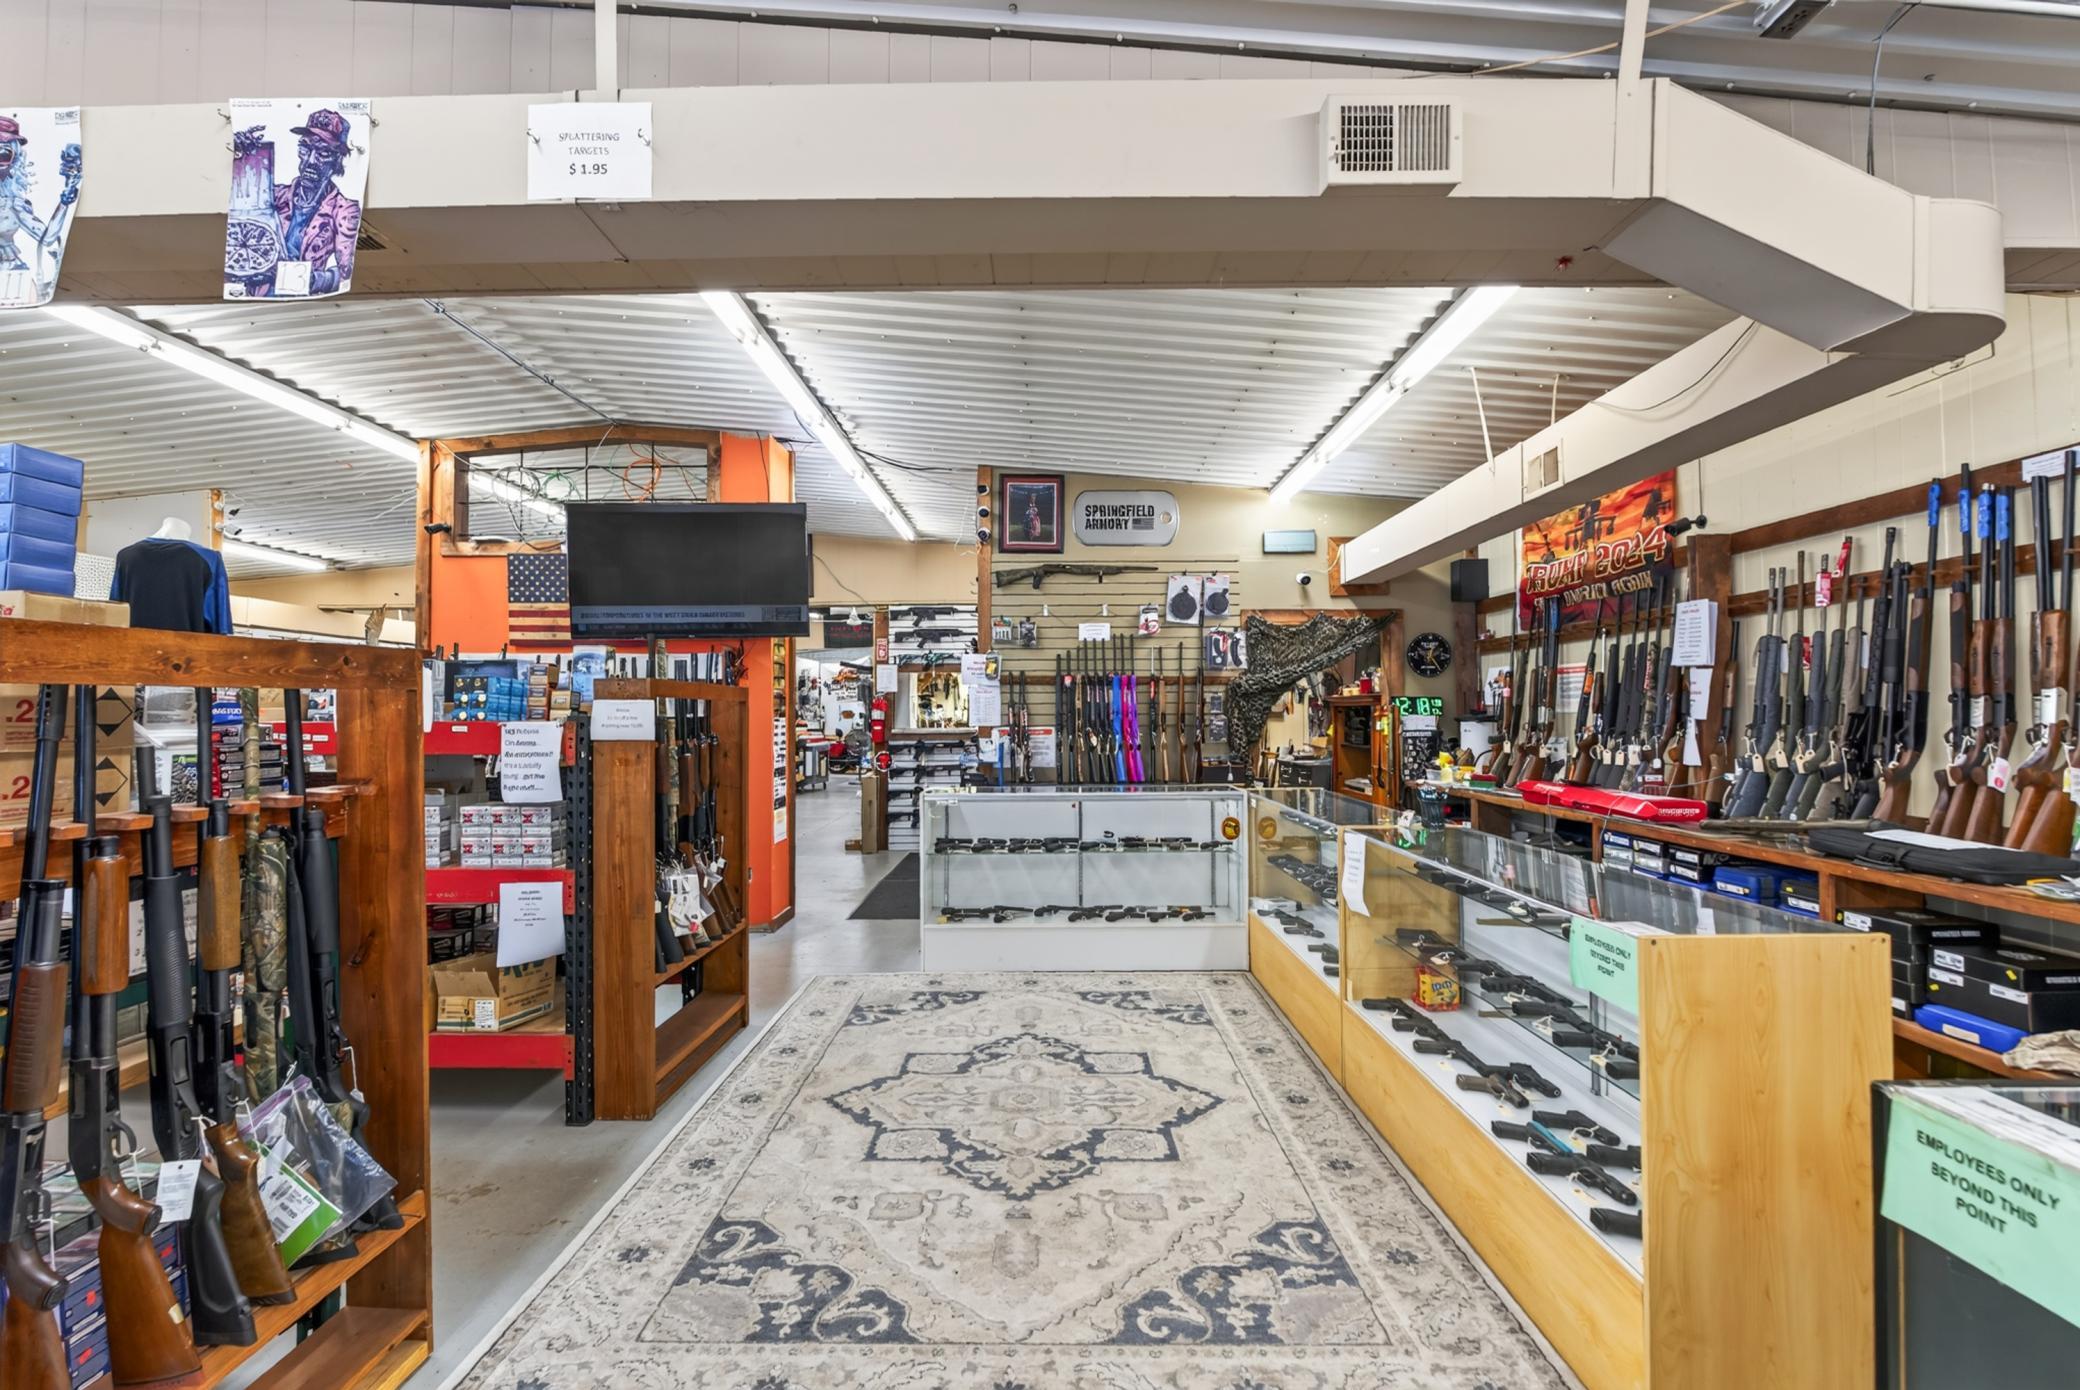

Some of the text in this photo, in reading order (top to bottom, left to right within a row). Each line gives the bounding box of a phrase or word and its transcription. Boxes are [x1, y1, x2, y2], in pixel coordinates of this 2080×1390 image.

[558, 132, 620, 142] SPLATTERING
[568, 146, 610, 156] TARGETS
[580, 163, 608, 175] 1.95
[1085, 504, 1155, 518] SPRINGFIELD
[1085, 518, 1130, 531] ARMORY
[1595, 524, 1668, 578] 2024
[1616, 946, 1631, 960] ONLY
[1916, 1129, 2061, 1210] EMPLOYEES ONLY
[1931, 1161, 2038, 1229] BEYOND THIS
[1956, 1196, 2007, 1233] POINT
